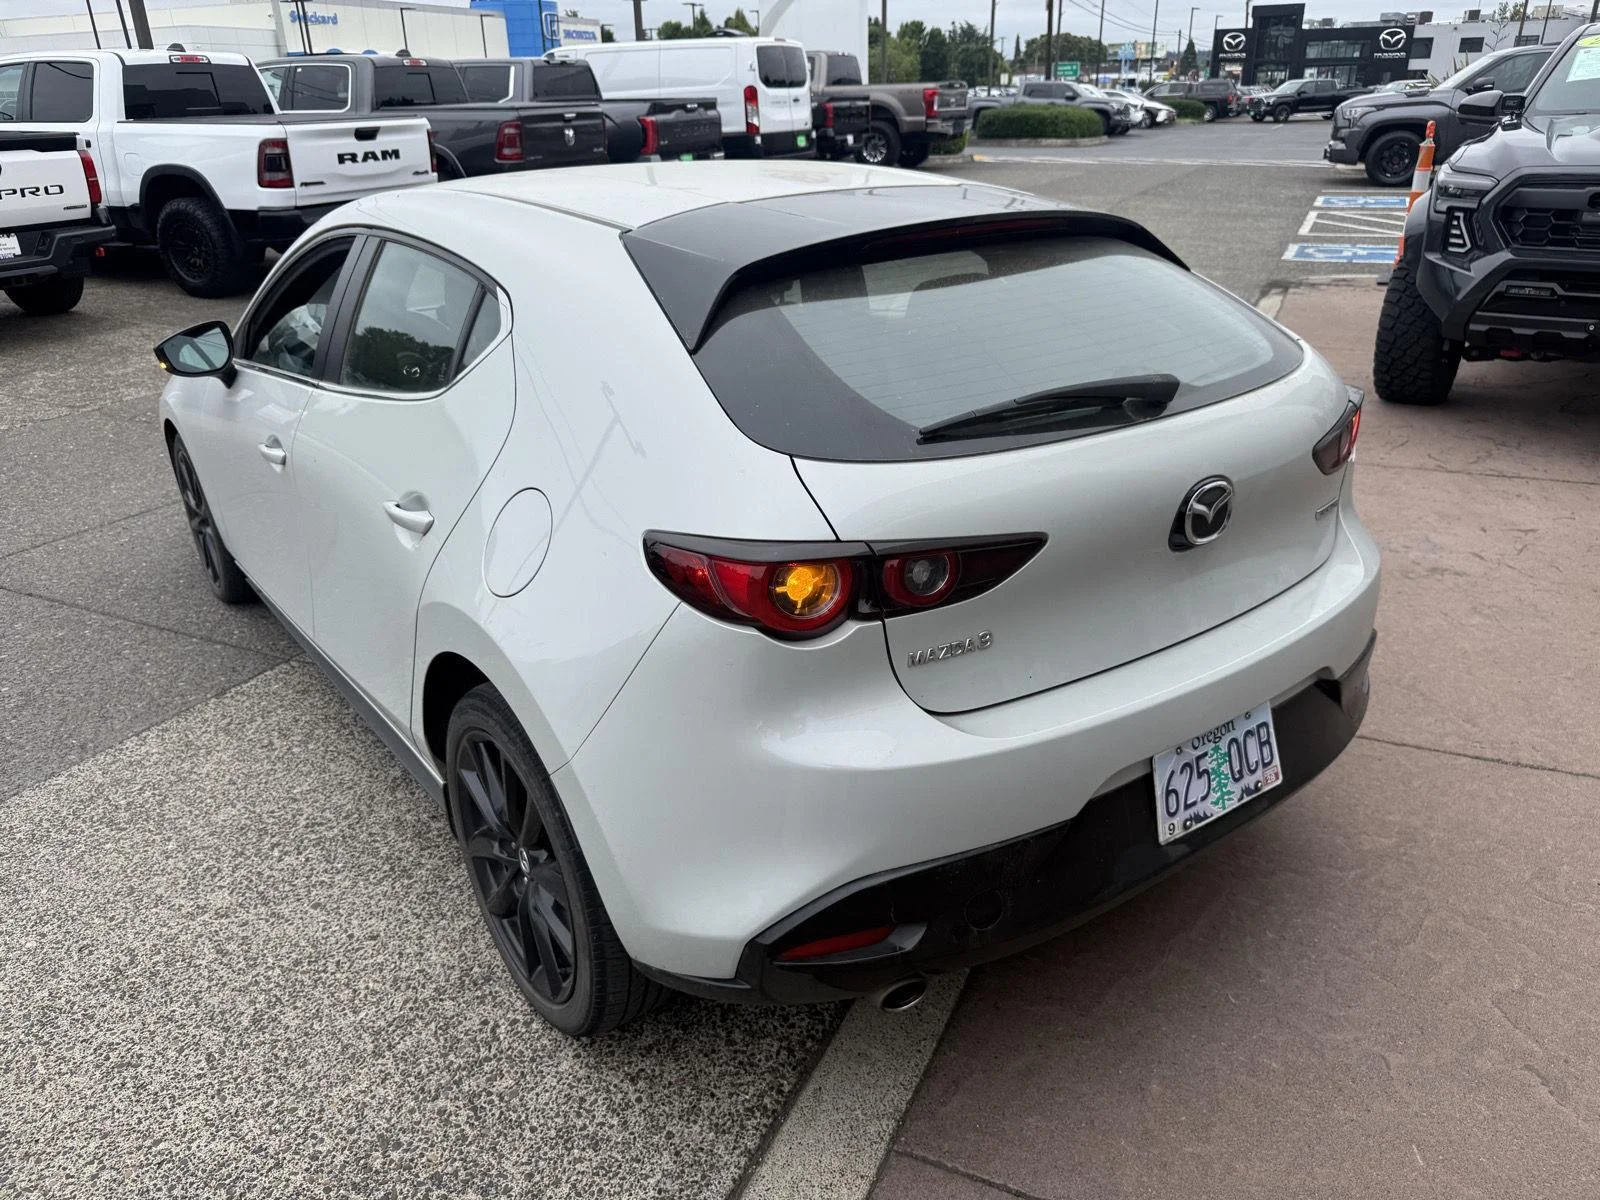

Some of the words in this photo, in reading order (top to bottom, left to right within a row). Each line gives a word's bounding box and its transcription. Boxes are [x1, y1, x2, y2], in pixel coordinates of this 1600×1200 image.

[289, 10, 338, 25] Sckard
[337, 149, 400, 164] RAM
[0, 184, 64, 199] PRO
[1191, 720, 1236, 750] Oregon
[1165, 751, 1211, 817] 625
[1227, 721, 1274, 783] QCB
[1168, 823, 1175, 835] 9
